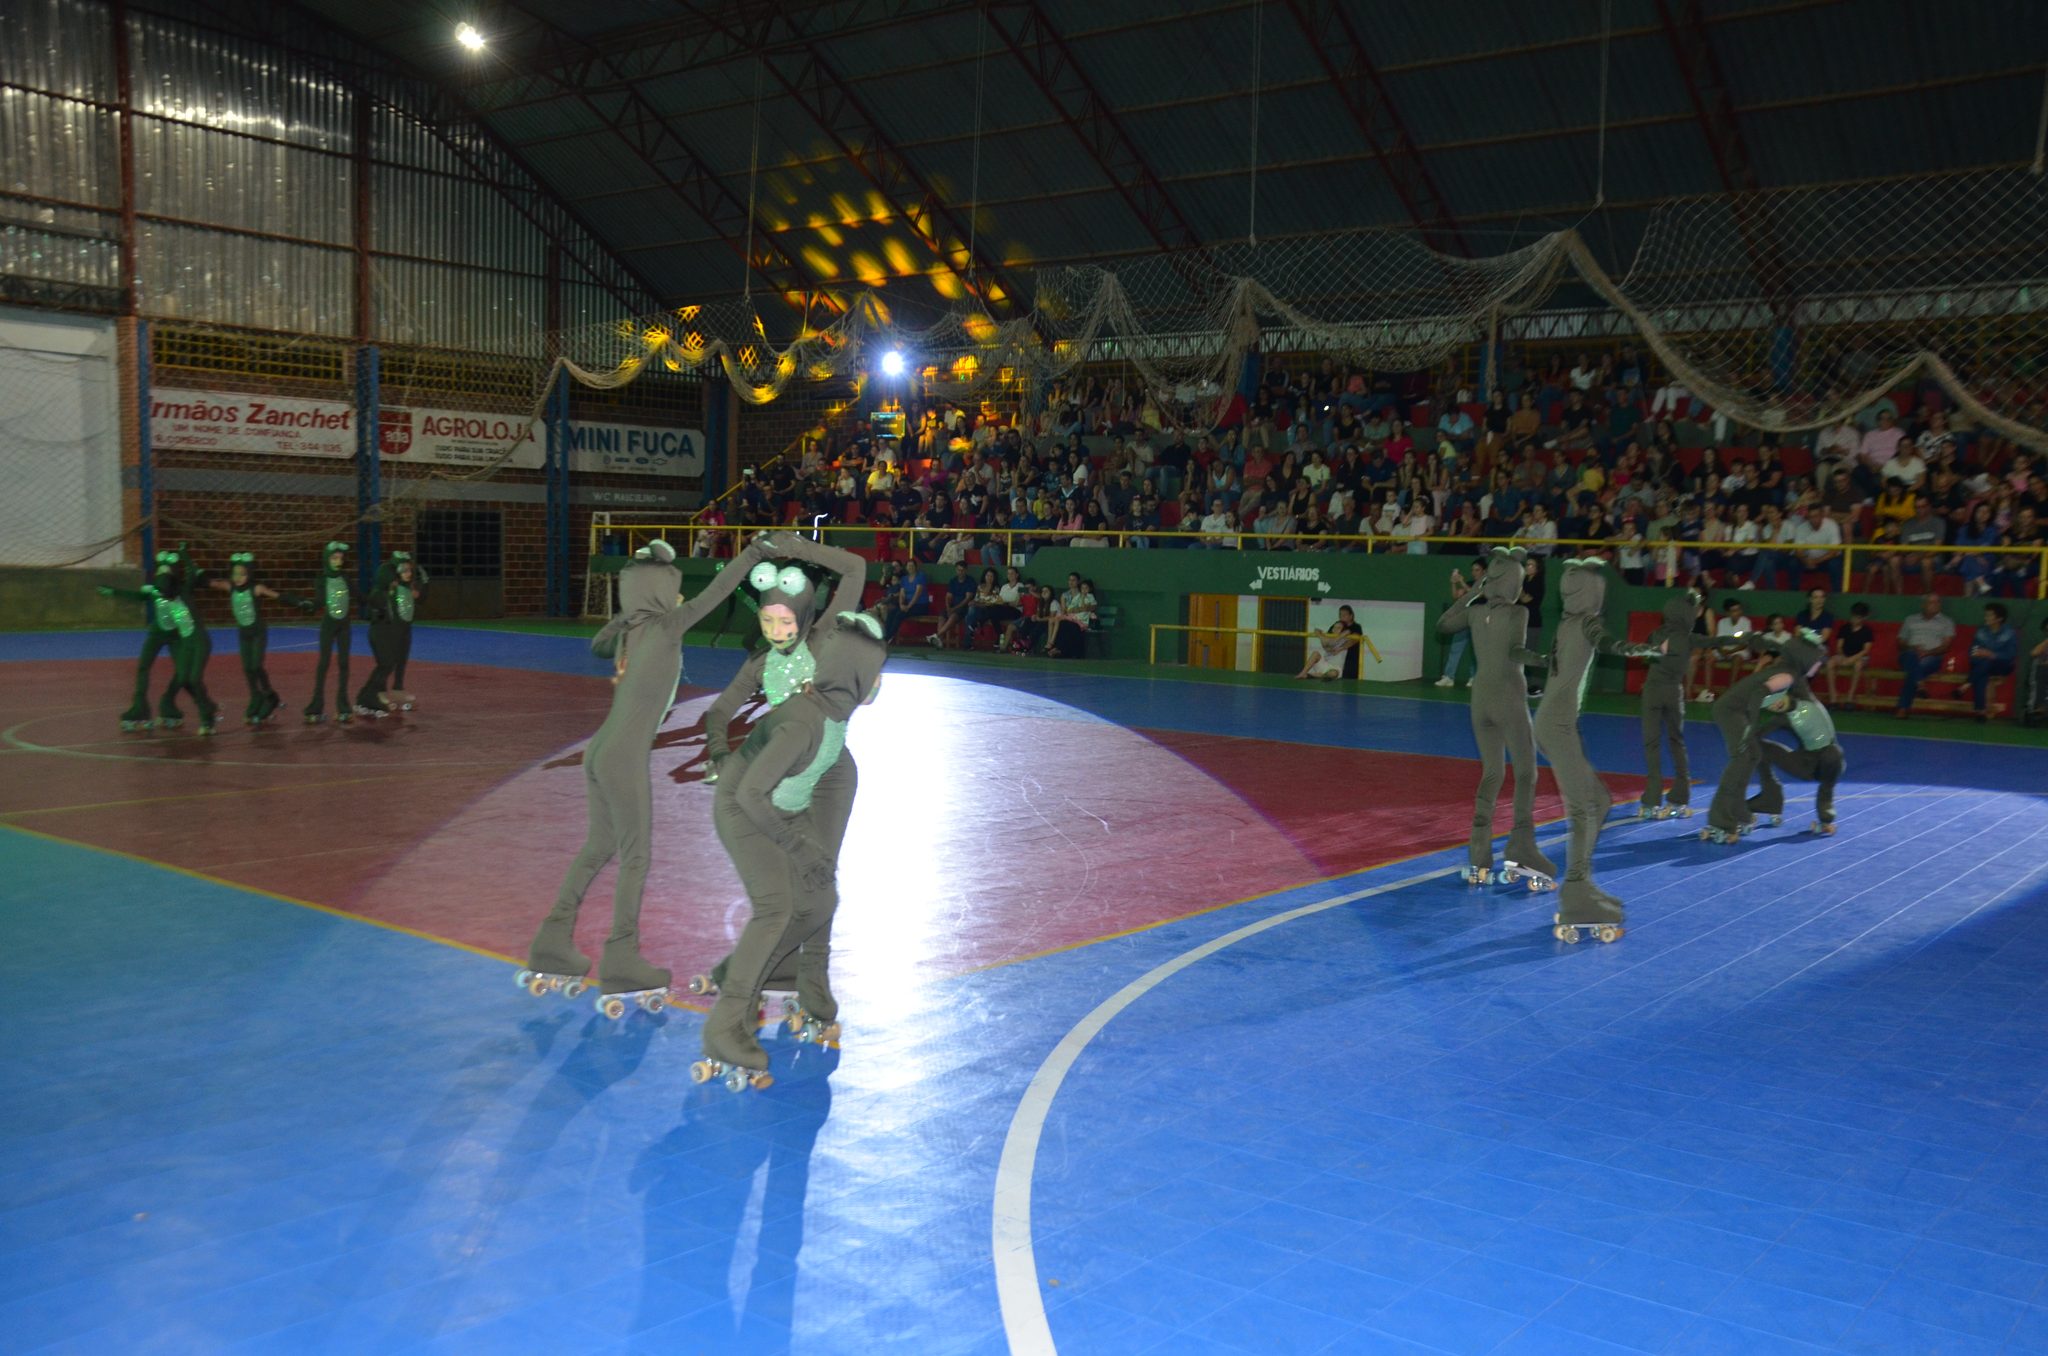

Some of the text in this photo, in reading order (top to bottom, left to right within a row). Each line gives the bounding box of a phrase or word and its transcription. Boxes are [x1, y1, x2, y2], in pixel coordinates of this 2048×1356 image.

[246, 402, 350, 431] Zanchet
[567, 426, 696, 459] MINI FUCA
[592, 492, 610, 502] WC
[1257, 566, 1320, 581] VESTIÁRIOS
